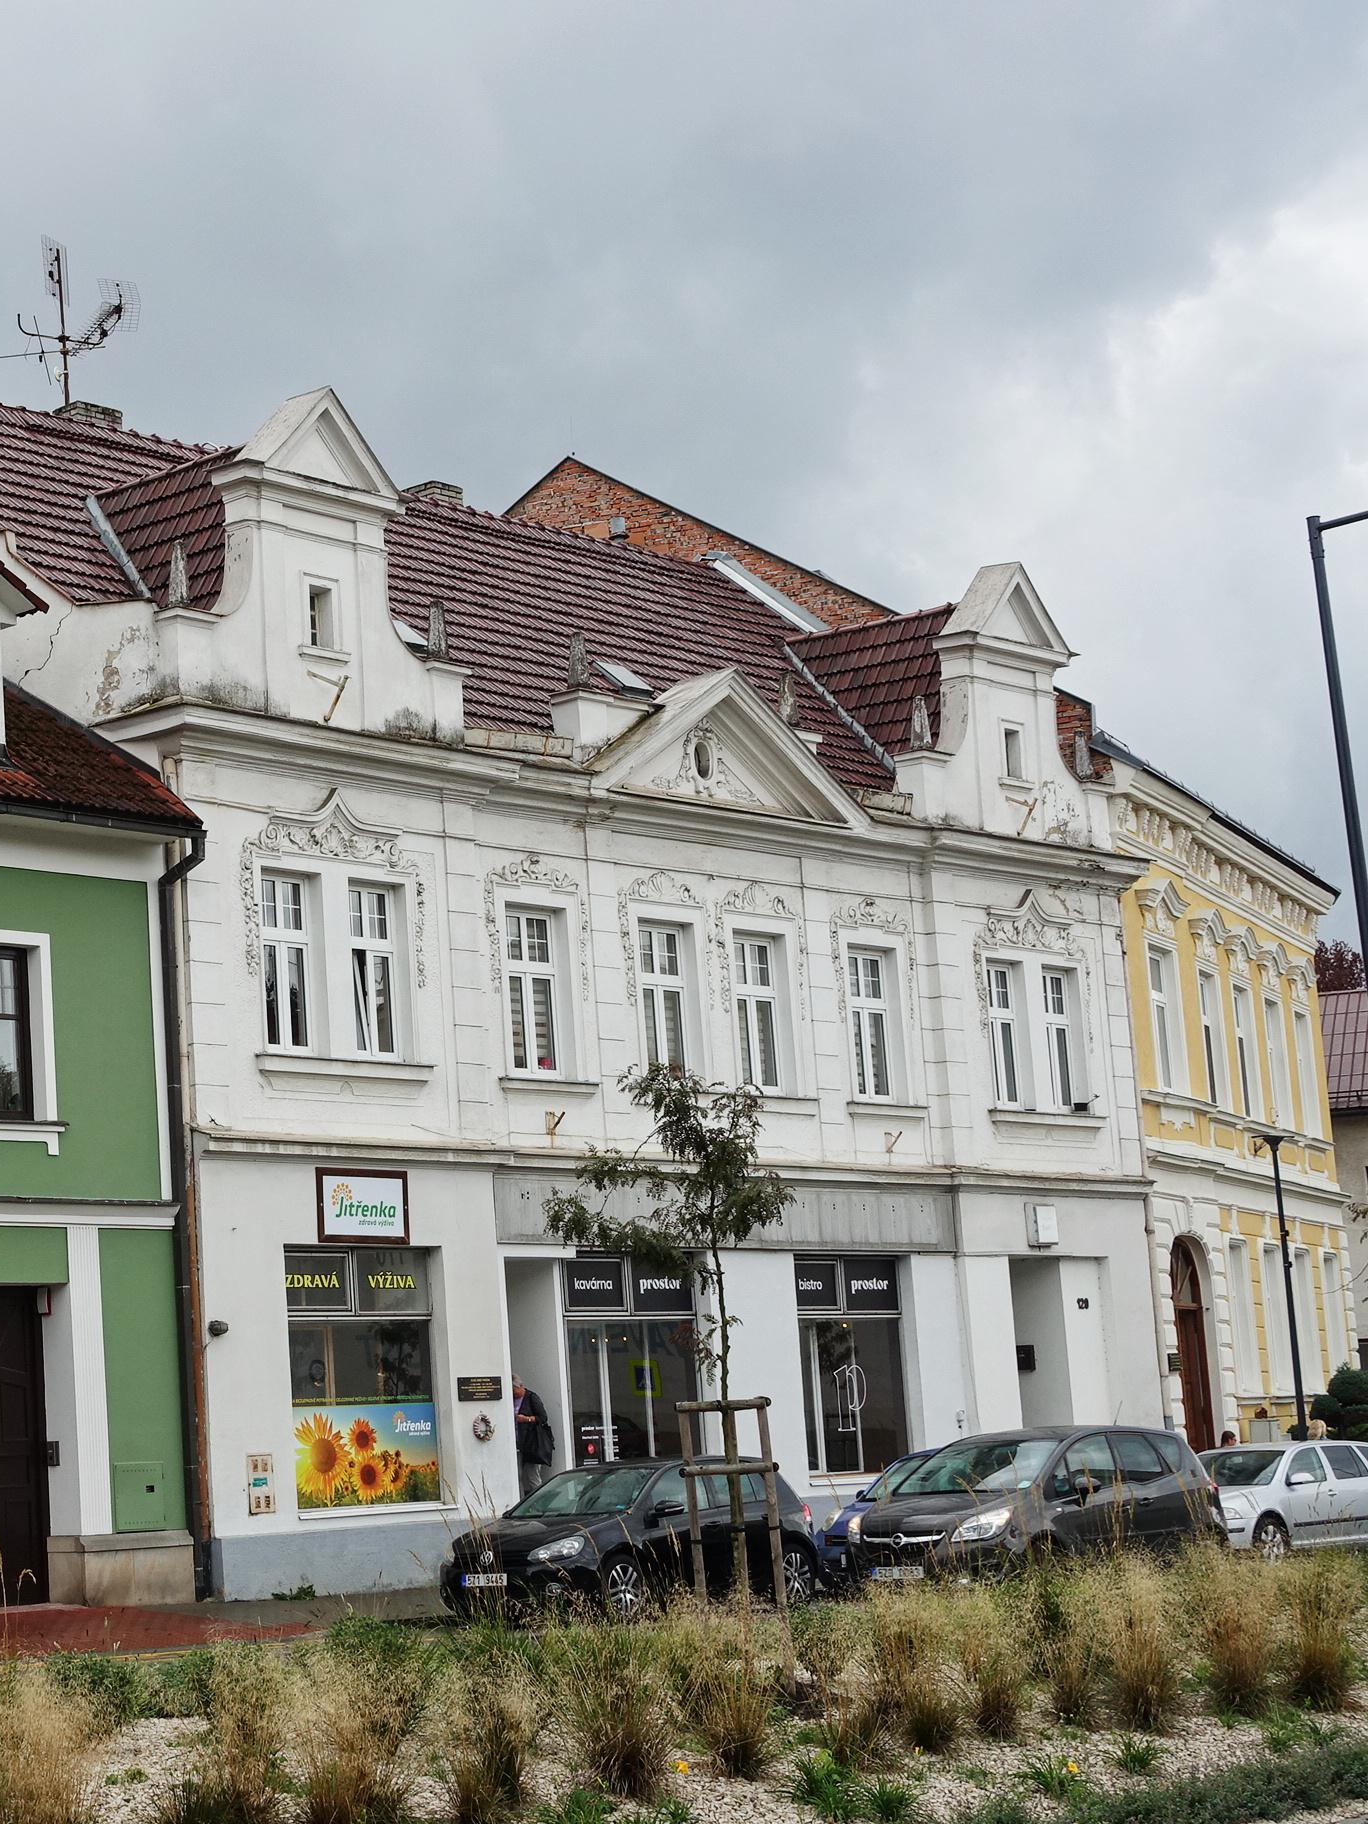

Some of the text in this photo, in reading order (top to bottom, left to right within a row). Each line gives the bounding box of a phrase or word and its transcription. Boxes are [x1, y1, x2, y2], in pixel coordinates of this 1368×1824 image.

[335, 1196, 397, 1218] Jitřenka
[285, 1271, 417, 1289] ZDRAVÁ VÝŽIVA
[574, 1275, 682, 1294] kavárna prostor
[798, 1277, 889, 1294] bistro prostor
[395, 1419, 431, 1433] Jitřenka
